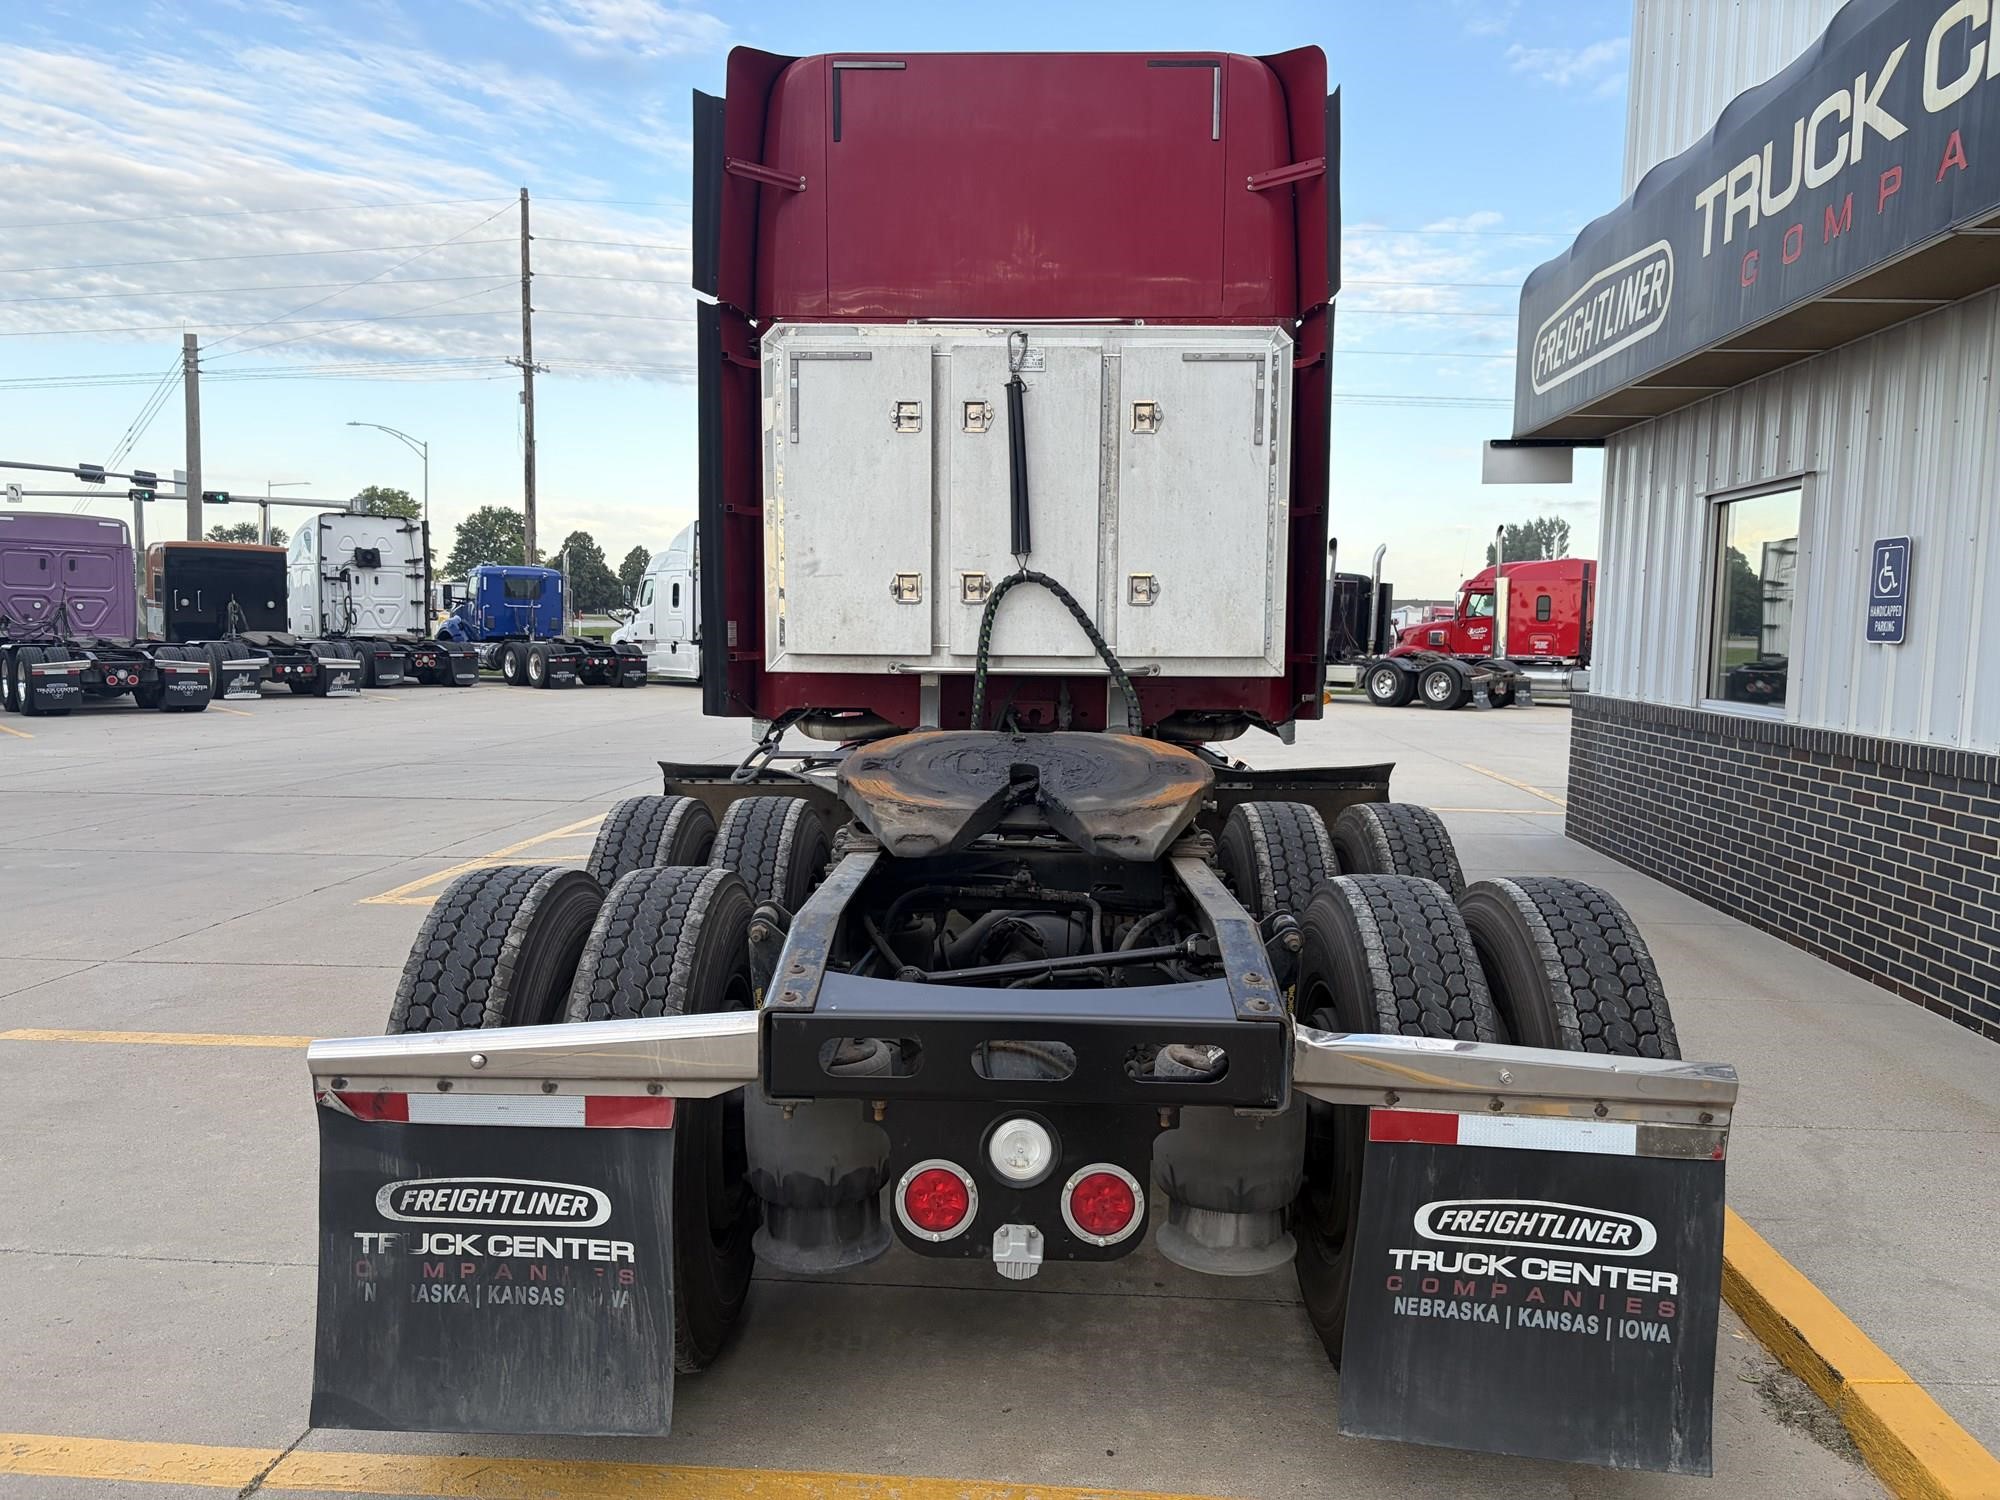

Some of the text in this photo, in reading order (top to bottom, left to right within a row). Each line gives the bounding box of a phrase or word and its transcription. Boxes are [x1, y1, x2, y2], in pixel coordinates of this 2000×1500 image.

[1695, 38, 1911, 258] TRUCK
[1741, 128, 1968, 288] COMPA
[1536, 259, 1667, 380] FREIGHTLINER
[1870, 605, 1903, 617] HANDICAPPED
[1874, 620, 1895, 632] PARKING
[399, 1188, 589, 1217] FREIGHTLINER
[1436, 1209, 1633, 1247] FREIGHTLINER
[487, 1235, 635, 1263] CENTER
[356, 1260, 635, 1285] CMPANS
[1388, 1248, 1679, 1296] TRUCK CENTER
[364, 1282, 470, 1304] NASKA
[488, 1285, 566, 1307] KANSAS
[1386, 1275, 1677, 1318] COMPANIES
[1393, 1296, 1500, 1324] NEBRASKA
[1517, 1307, 1600, 1335] KANSAS
[1618, 1318, 1672, 1344] IOWA
